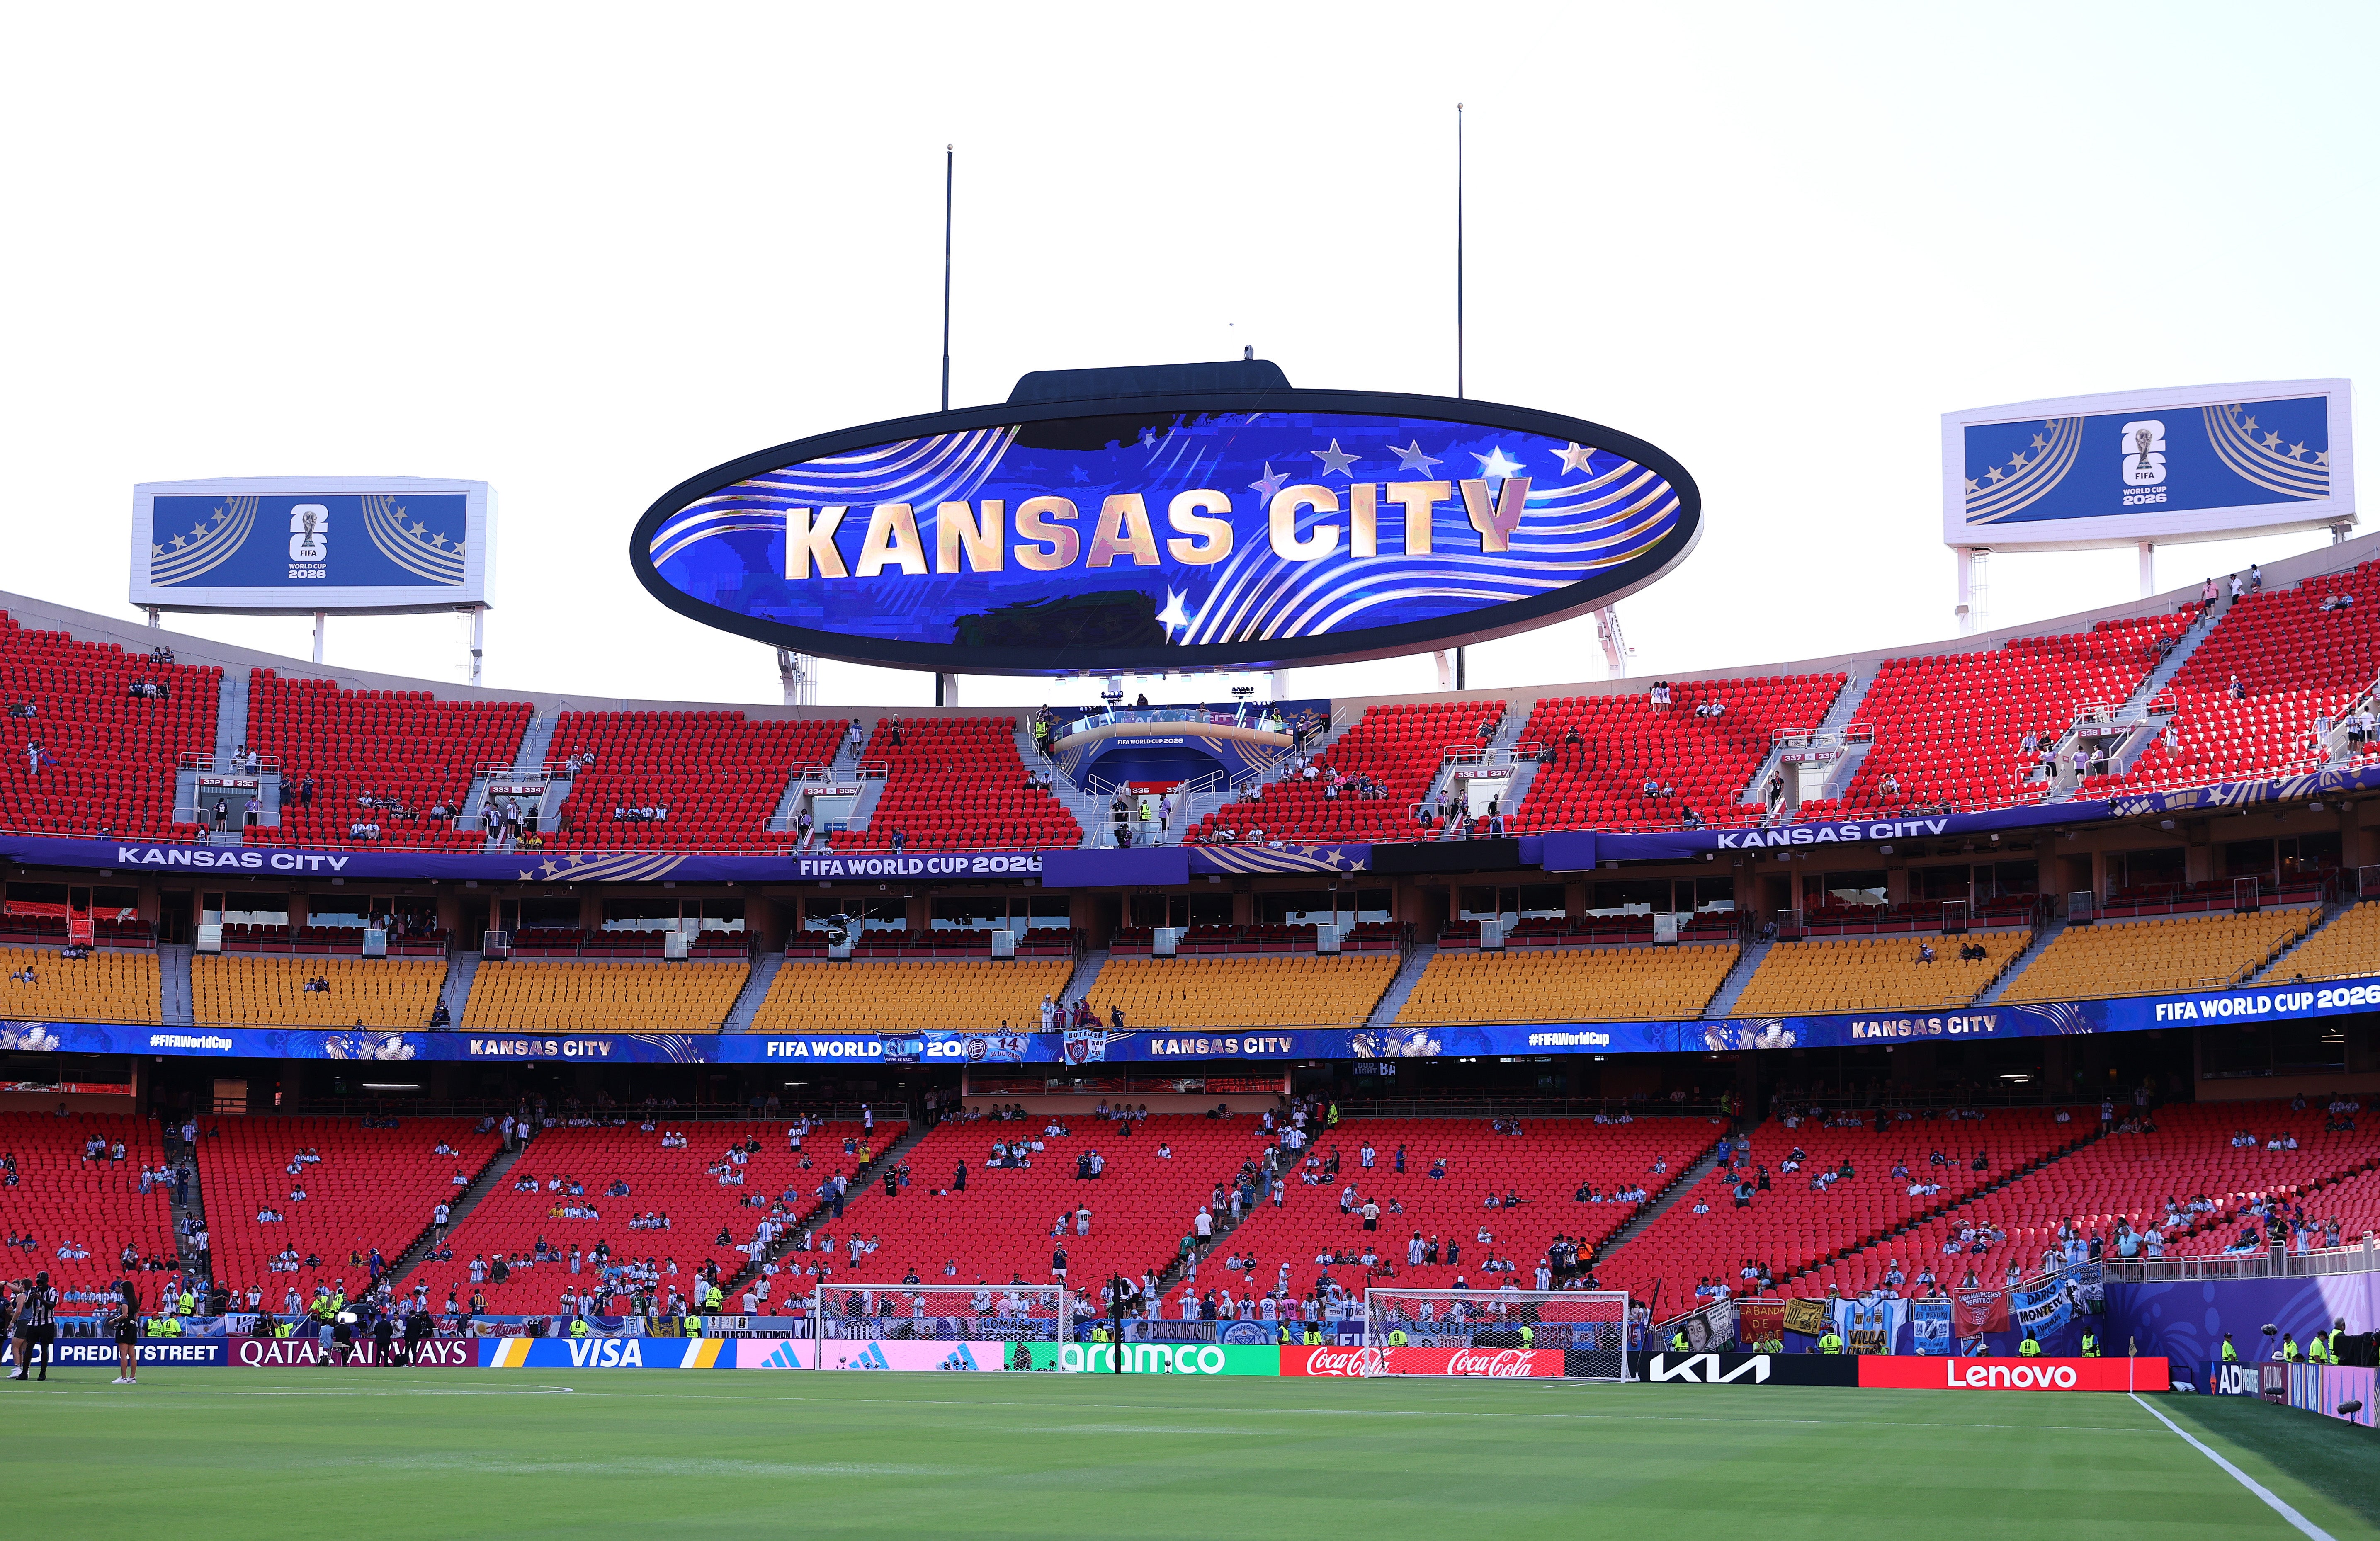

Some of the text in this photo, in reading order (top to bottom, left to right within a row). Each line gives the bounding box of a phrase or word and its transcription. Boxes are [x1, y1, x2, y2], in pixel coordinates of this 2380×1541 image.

[2135, 472, 2154, 481] FIFA
[2123, 493, 2167, 505] 2026
[784, 476, 1534, 580] KANSAS CITY
[289, 570, 326, 578] 2026
[1718, 819, 1947, 849] KANSAS CITY
[119, 847, 349, 871] KANSAS CITY
[800, 856, 1042, 875] FIFA WORLD CUP 2026
[2156, 985, 2380, 1022] FIFA WORLD CUP 2026
[1852, 1014, 1997, 1039] KANSAS CITY
[150, 1035, 232, 1051] #FIFAWorldCup
[998, 1037, 1019, 1051] 14
[1151, 1038, 1293, 1054] KANSAS CITY
[1528, 1031, 1610, 1047] #FIFAWorldCup
[471, 1040, 612, 1056] KANSAS CITY
[767, 1041, 808, 1056] FIFA
[814, 1041, 882, 1057] WORLD
[2027, 1284, 2057, 1306] DARIO
[635, 1300, 640, 1308] 5
[1345, 1308, 1354, 1317] 10
[1740, 1306, 1752, 1315] LA
[1753, 1306, 1785, 1315] BANDA
[487, 1320, 522, 1337] Alsina
[1152, 1320, 1201, 1341] EXCURSIONISTAS
[1753, 1319, 1769, 1328] DE
[1848, 1330, 1887, 1346] VILLA
[561, 1339, 643, 1367] VISA
[1061, 1343, 1225, 1373] aramco
[1306, 1347, 1395, 1376] Coca-Cola
[1447, 1349, 1537, 1376] Coca-Cola
[1650, 1352, 1770, 1384] KIA
[1947, 1359, 2077, 1388] Lenovo
